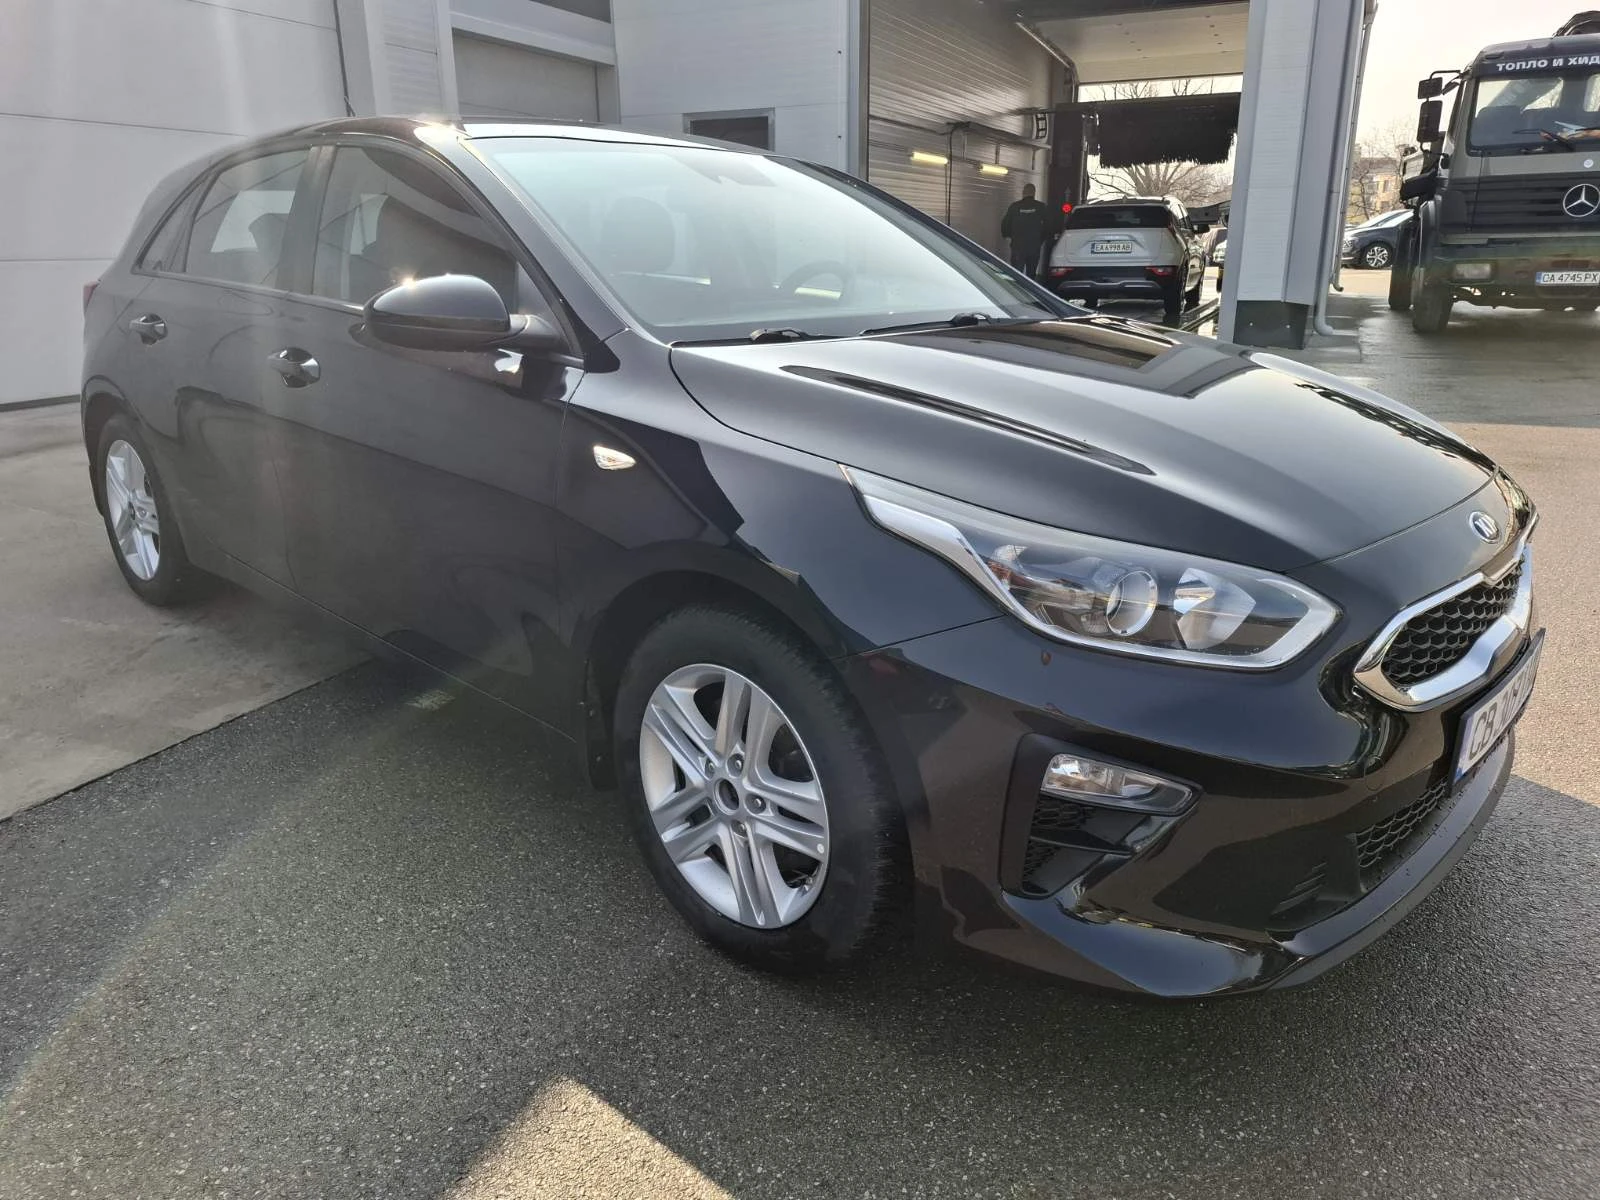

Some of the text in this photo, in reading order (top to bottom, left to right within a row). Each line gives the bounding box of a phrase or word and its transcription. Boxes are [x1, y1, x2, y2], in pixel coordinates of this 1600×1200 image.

[1496, 59, 1548, 71] ТОПЛО
[1552, 58, 1563, 67] И
[1558, 273, 1582, 282] 4745
